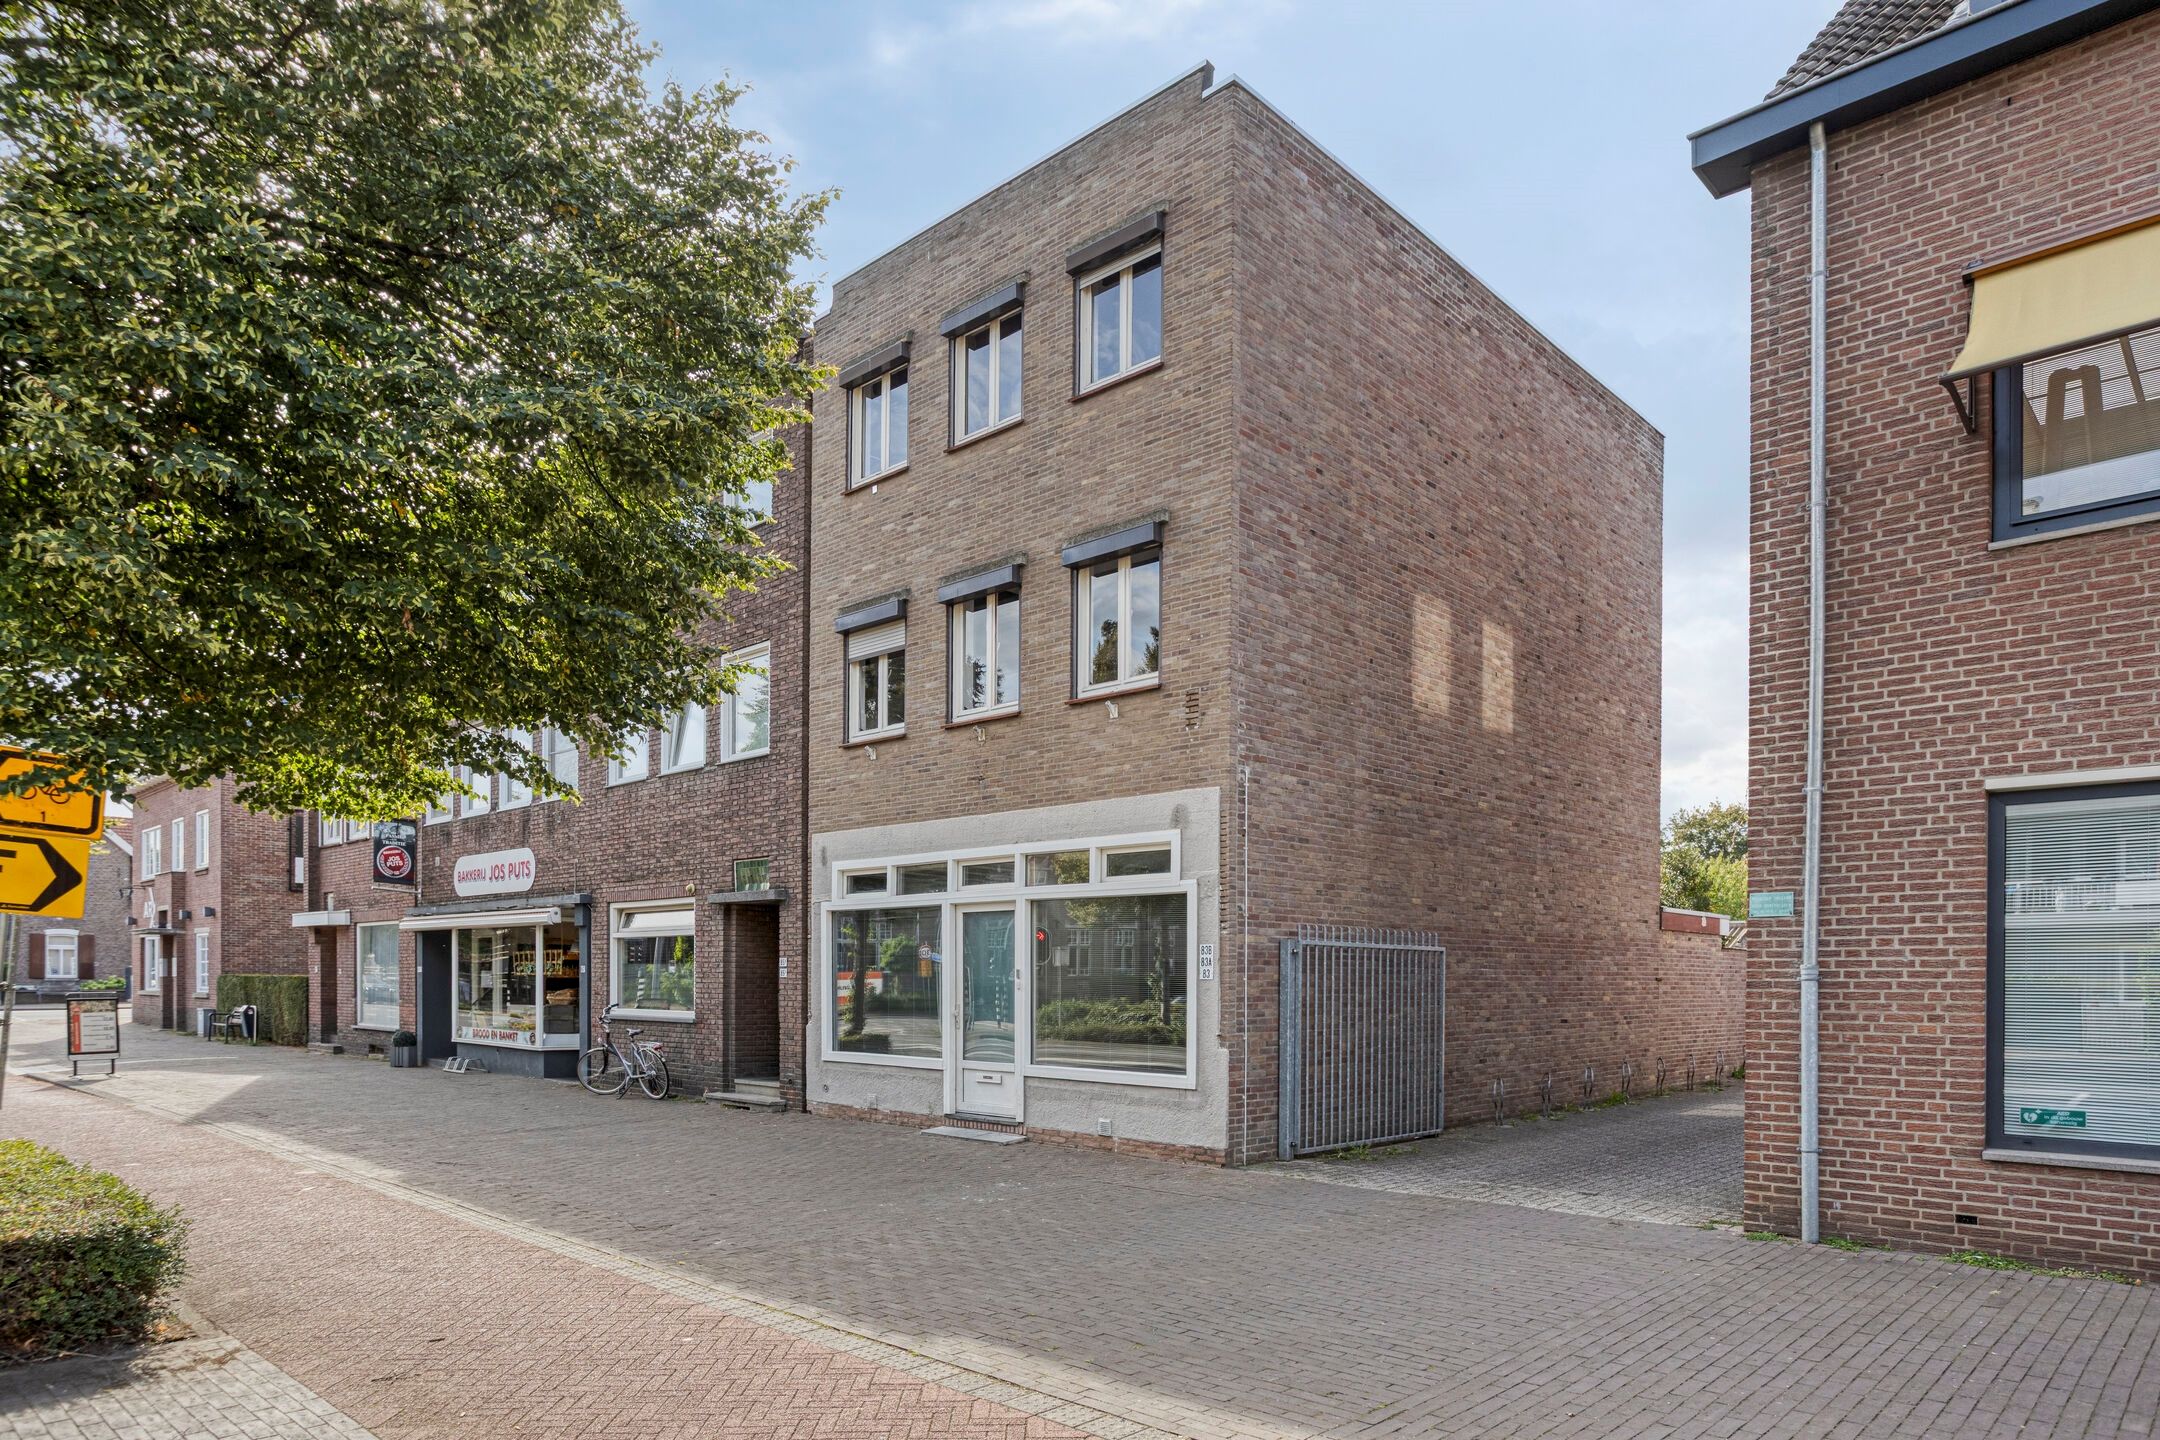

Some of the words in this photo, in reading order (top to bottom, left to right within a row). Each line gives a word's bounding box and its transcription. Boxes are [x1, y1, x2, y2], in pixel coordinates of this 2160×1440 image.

[40, 811, 46, 822] 1
[457, 868, 487, 882] BAKKERIJ
[489, 863, 506, 882] JOS
[508, 860, 532, 879] PUTS
[1201, 945, 1212, 955] 83B
[1201, 957, 1212, 967] 83A
[1203, 969, 1211, 978] 83
[473, 1028, 490, 1039] BROOD
[491, 1030, 498, 1040] EN
[499, 1031, 519, 1043] BANKET
